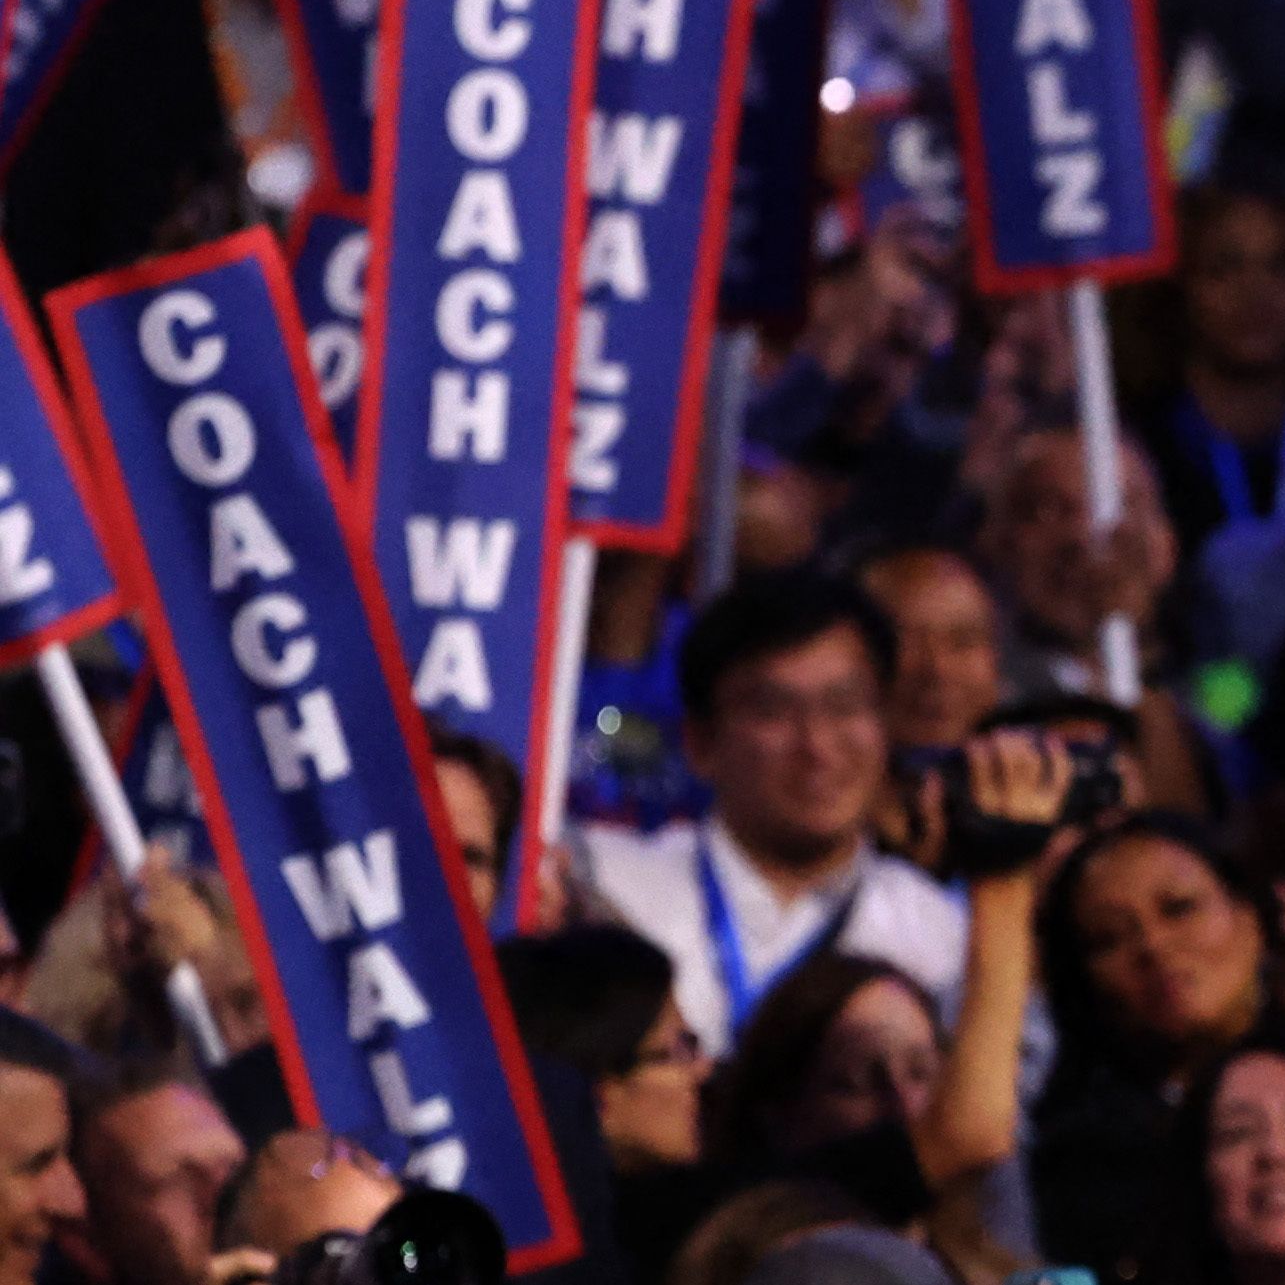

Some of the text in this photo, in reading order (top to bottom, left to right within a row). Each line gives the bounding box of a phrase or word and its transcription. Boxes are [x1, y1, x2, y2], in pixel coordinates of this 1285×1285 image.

[566, 112, 683, 493] WALZ
[138, 289, 351, 792] COACH
[405, 516, 517, 711] WA
